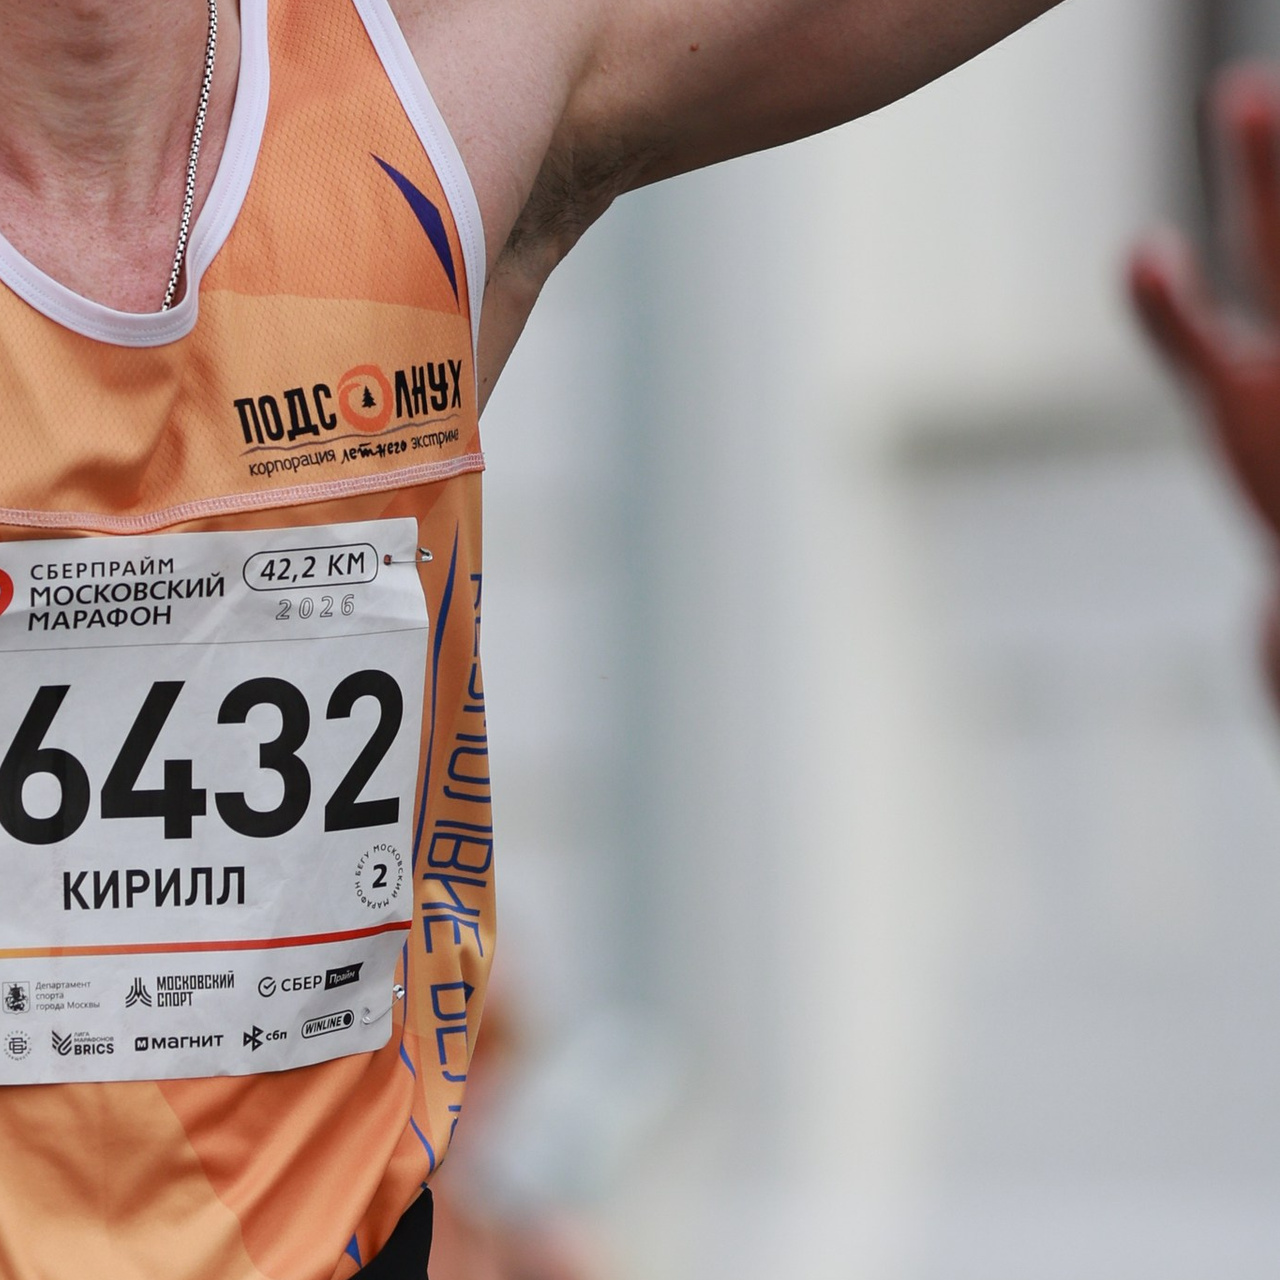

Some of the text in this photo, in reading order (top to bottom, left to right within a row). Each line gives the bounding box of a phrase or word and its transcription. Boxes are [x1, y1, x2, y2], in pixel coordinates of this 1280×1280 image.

[249, 449, 337, 477] корпорация
[30, 557, 175, 581] СБЕРПРАЙМ
[260, 551, 365, 584] 42,2 КМ
[29, 572, 225, 608] МОСКОВСКИЙ
[275, 594, 356, 620] 2026
[27, 605, 172, 632] МАРАФОН
[372, 863, 388, 889] 2
[62, 866, 246, 911] КИРИЛЛ
[35, 981, 91, 991] Департамент
[156, 971, 235, 991] МОСКОВСКИЙ
[280, 975, 323, 993] СБЕР
[35, 992, 64, 1001] спорта
[36, 1001, 100, 1011] города Москвы
[157, 991, 194, 1008] СПОРТ
[305, 1015, 342, 1035] WINLINE
[74, 1043, 114, 1056] BRICS
